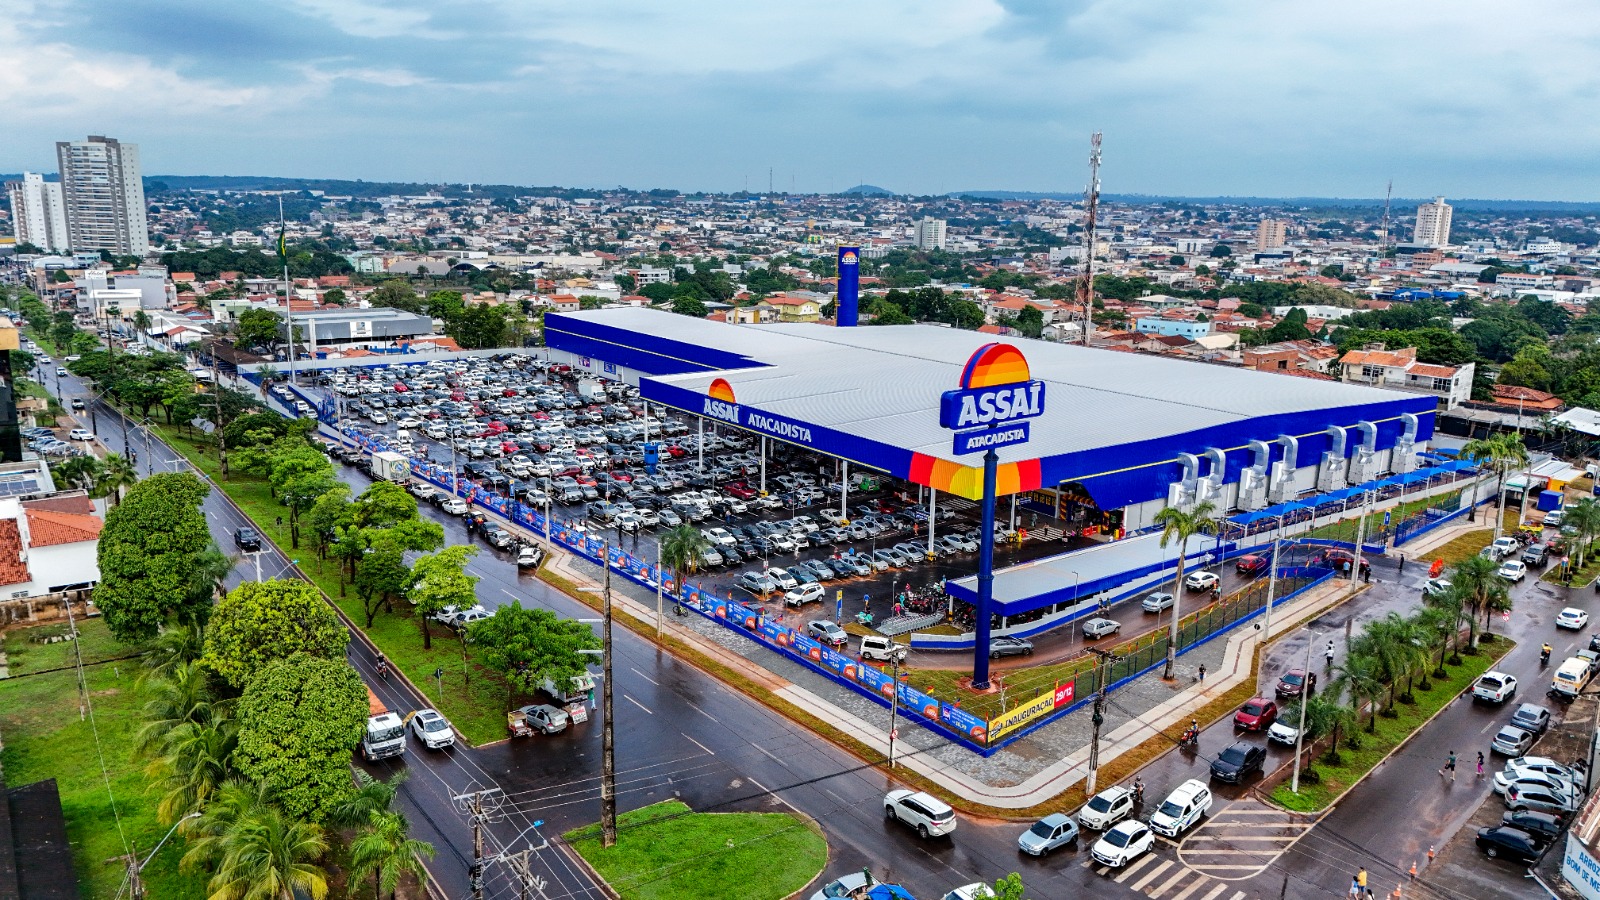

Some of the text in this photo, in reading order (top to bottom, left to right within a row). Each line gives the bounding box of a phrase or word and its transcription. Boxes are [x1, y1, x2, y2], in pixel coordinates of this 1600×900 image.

[958, 382, 1041, 426] ASSAÍ
[703, 398, 812, 443] ASSAÍ ATACADISTA
[966, 429, 1025, 449] ATACADISTA
[1056, 686, 1072, 703] 29/12
[1005, 697, 1054, 728] INAUGURAÇÃO
[1567, 856, 1580, 874] BOM
[1581, 869, 1590, 882] DE
